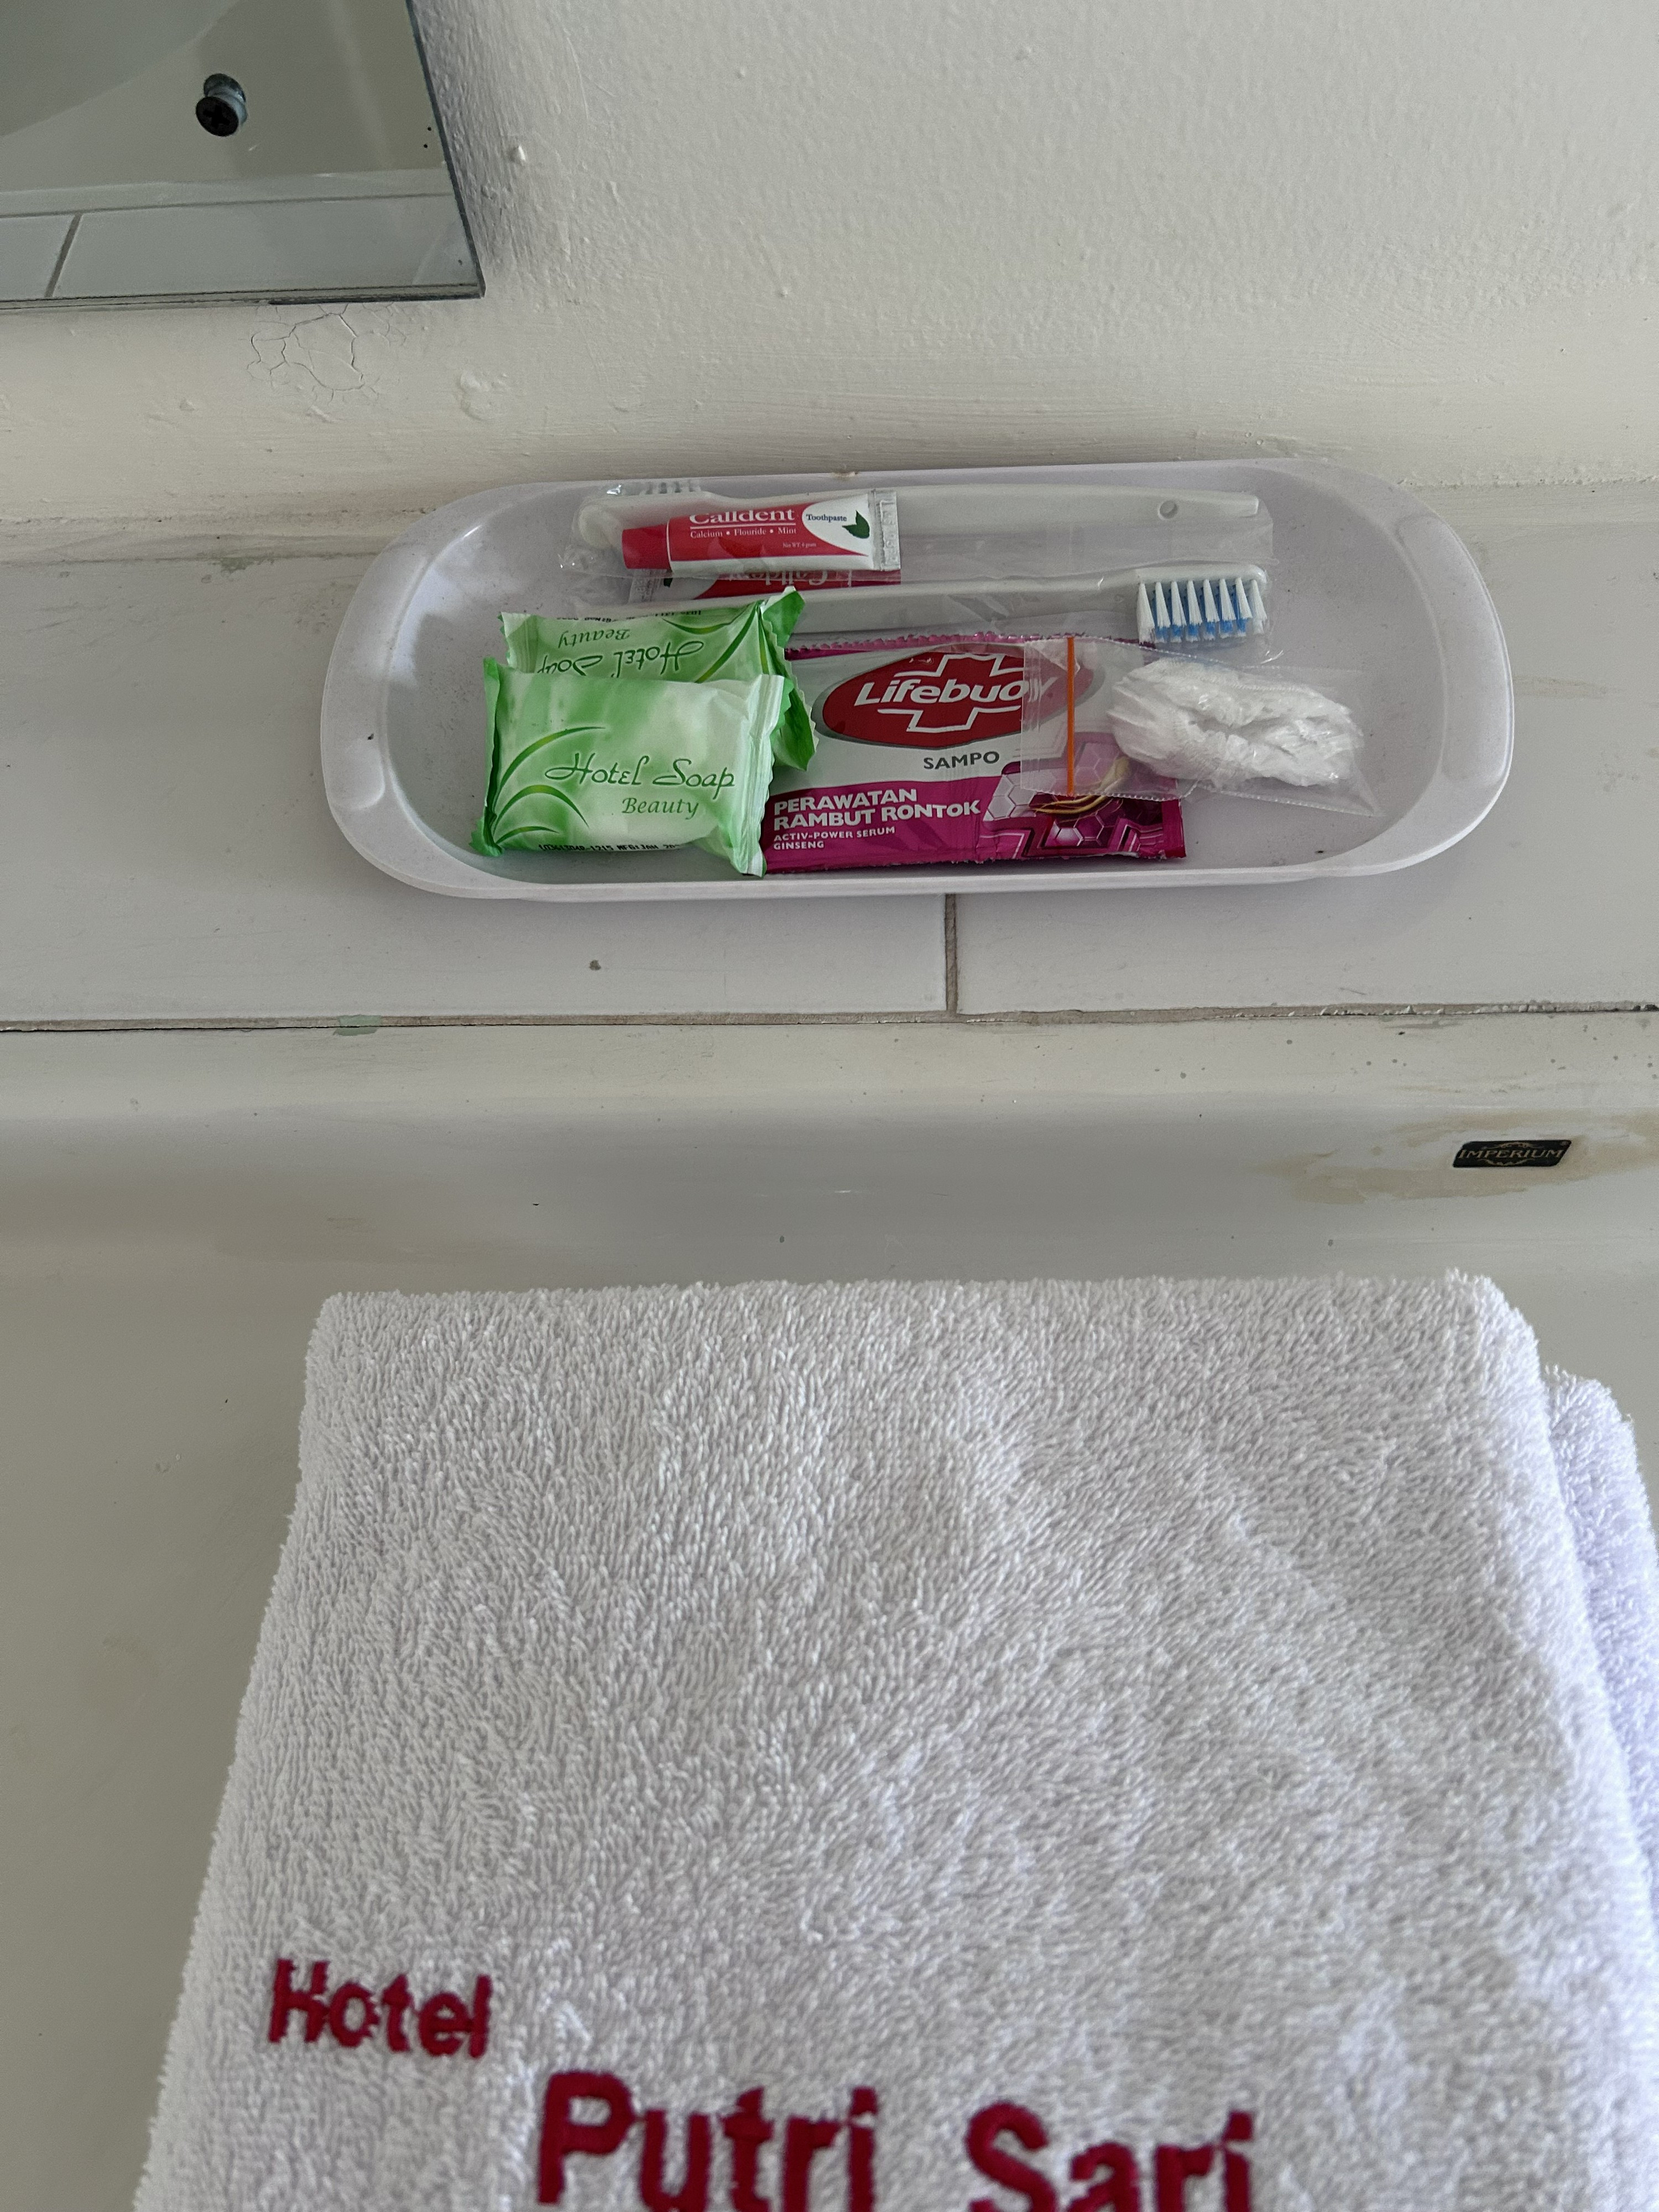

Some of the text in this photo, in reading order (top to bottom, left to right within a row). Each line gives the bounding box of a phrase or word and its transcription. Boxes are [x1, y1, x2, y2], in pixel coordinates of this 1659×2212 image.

[806, 514, 847, 523] Toothpaste
[691, 526, 796, 539] Calcium Flouride Mint
[558, 629, 630, 649] Beauty
[611, 641, 704, 678] Hotel
[854, 677, 1058, 706] Lifebuoy
[924, 751, 1000, 770] SAMPO
[545, 753, 735, 800] Hotel Soap
[622, 797, 699, 820] Beauty
[774, 789, 917, 815] PERAWATAN
[774, 800, 980, 831] RAMBUT RONTOK
[774, 826, 895, 842] ACTIV-POWER SERUM
[774, 841, 825, 851] GINSENG
[1458, 1150, 1564, 1159] IMPERIUM
[268, 1959, 493, 2058] Hotel
[538, 2071, 1254, 2212] Putri Sari
